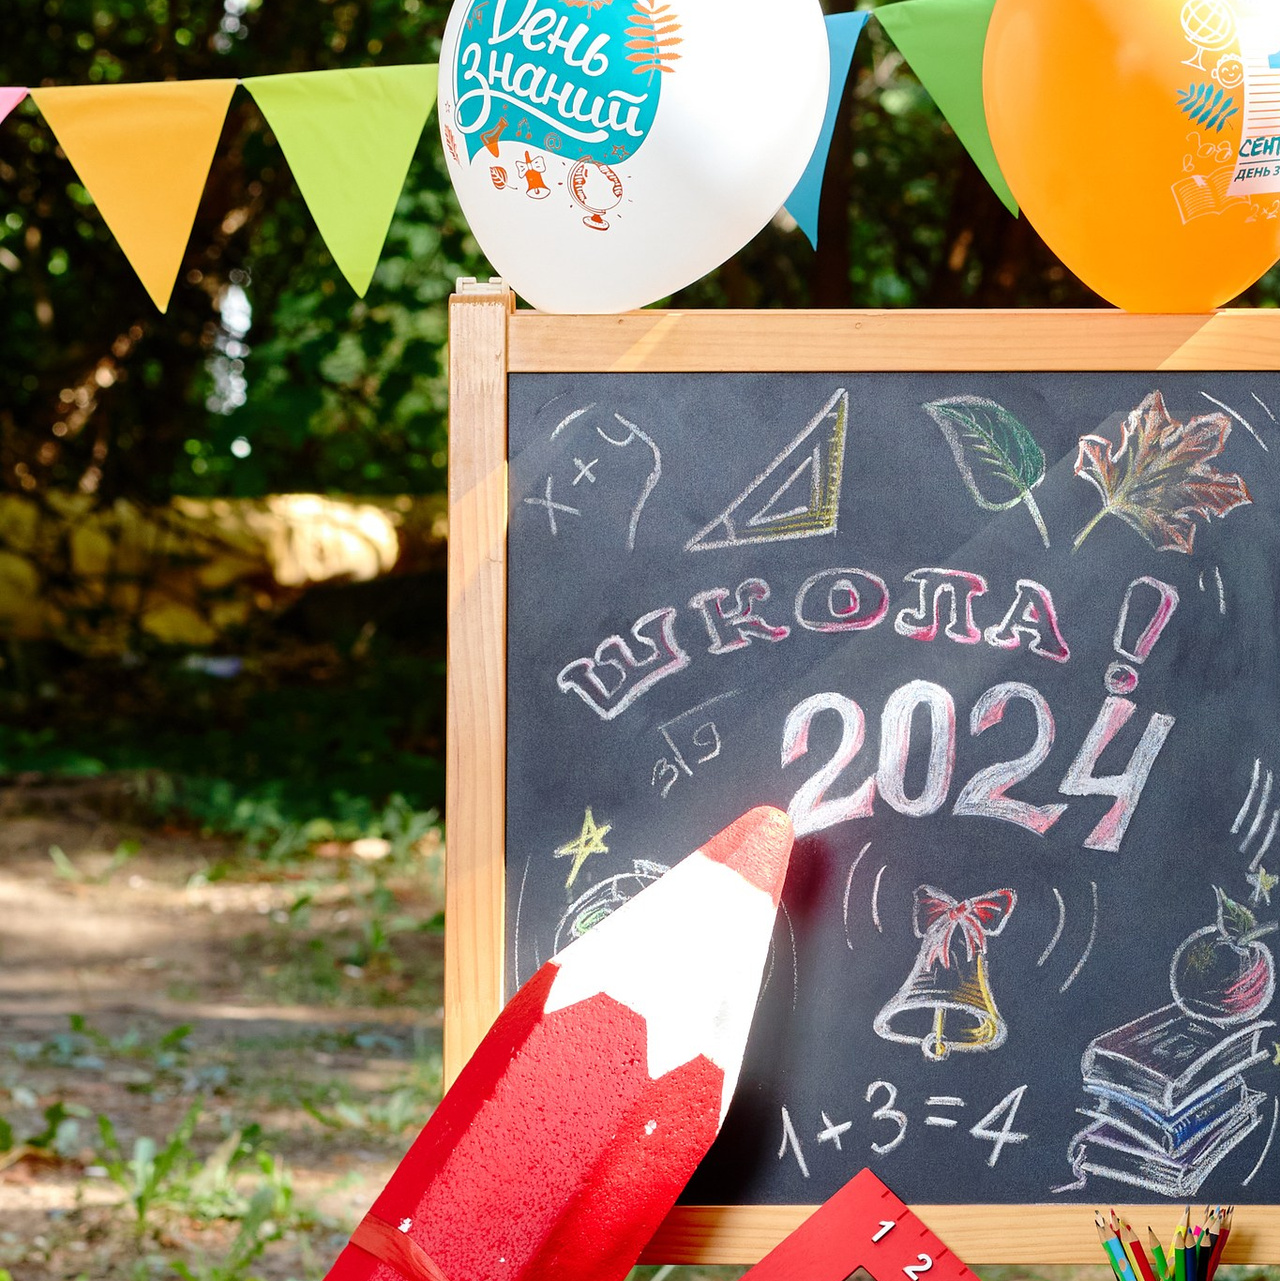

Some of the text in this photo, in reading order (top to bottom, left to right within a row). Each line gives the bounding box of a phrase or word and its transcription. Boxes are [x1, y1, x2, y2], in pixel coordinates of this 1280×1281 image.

[1234, 166, 1270, 182] ДЕНЬ
[780, 678, 1176, 852] 2024
[871, 1220, 895, 1243] 1
[903, 1253, 933, 1281] 2
